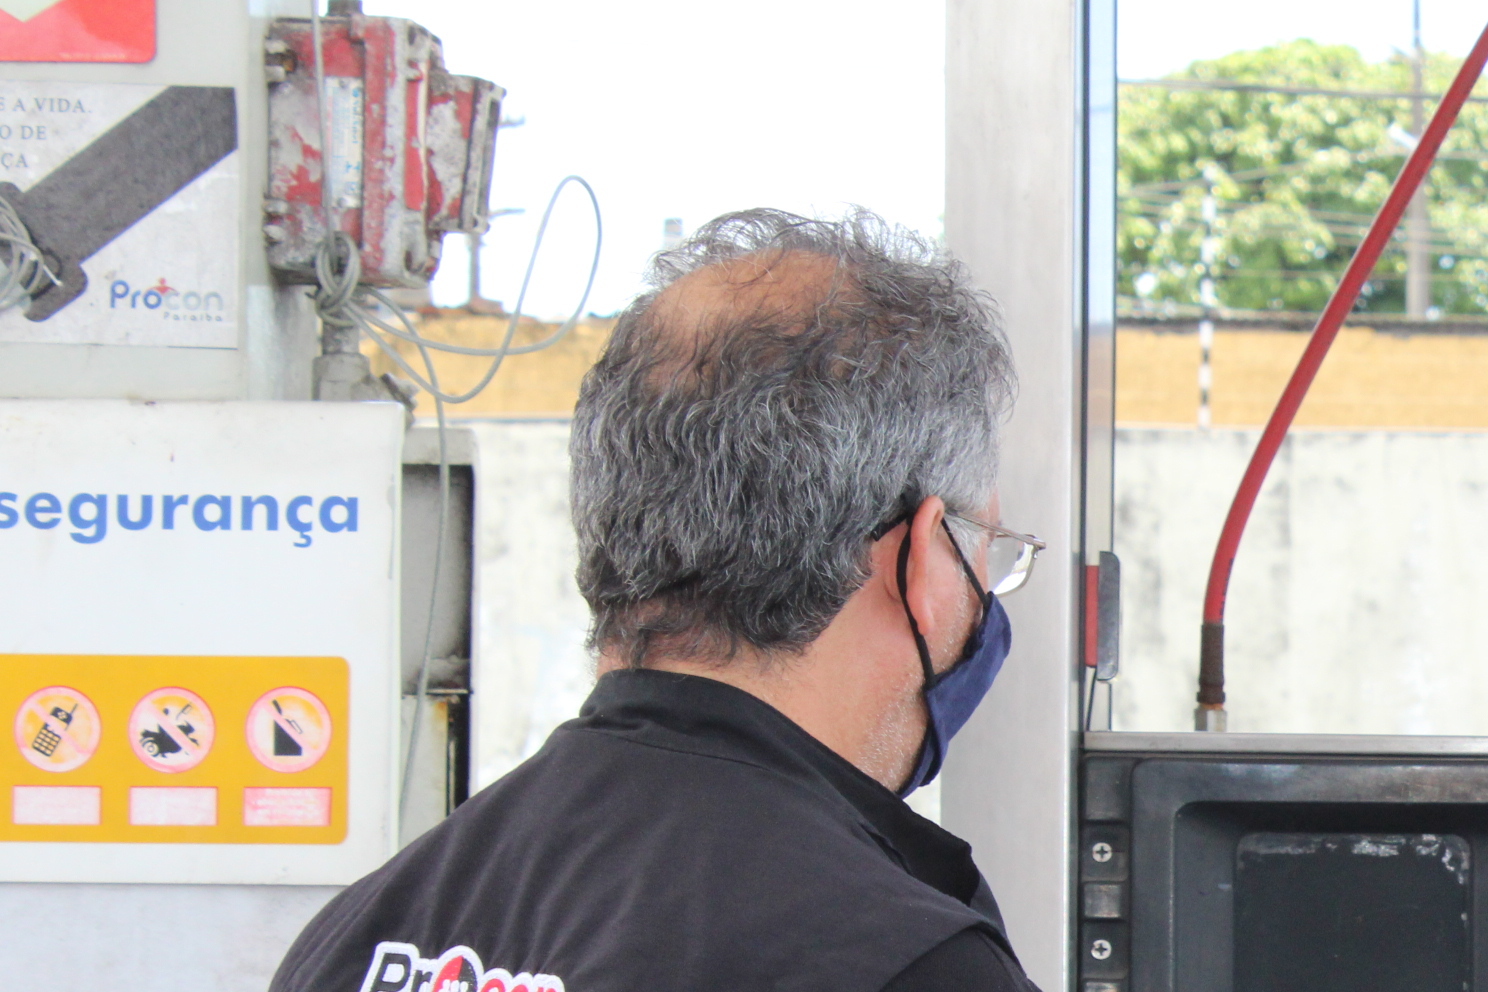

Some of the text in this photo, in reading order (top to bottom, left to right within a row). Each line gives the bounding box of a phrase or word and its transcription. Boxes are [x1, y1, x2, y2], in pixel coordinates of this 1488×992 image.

[34, 98, 92, 113] VIDA.
[21, 126, 47, 140] DE
[110, 280, 223, 310] Procon
[0, 491, 359, 548] segurança
